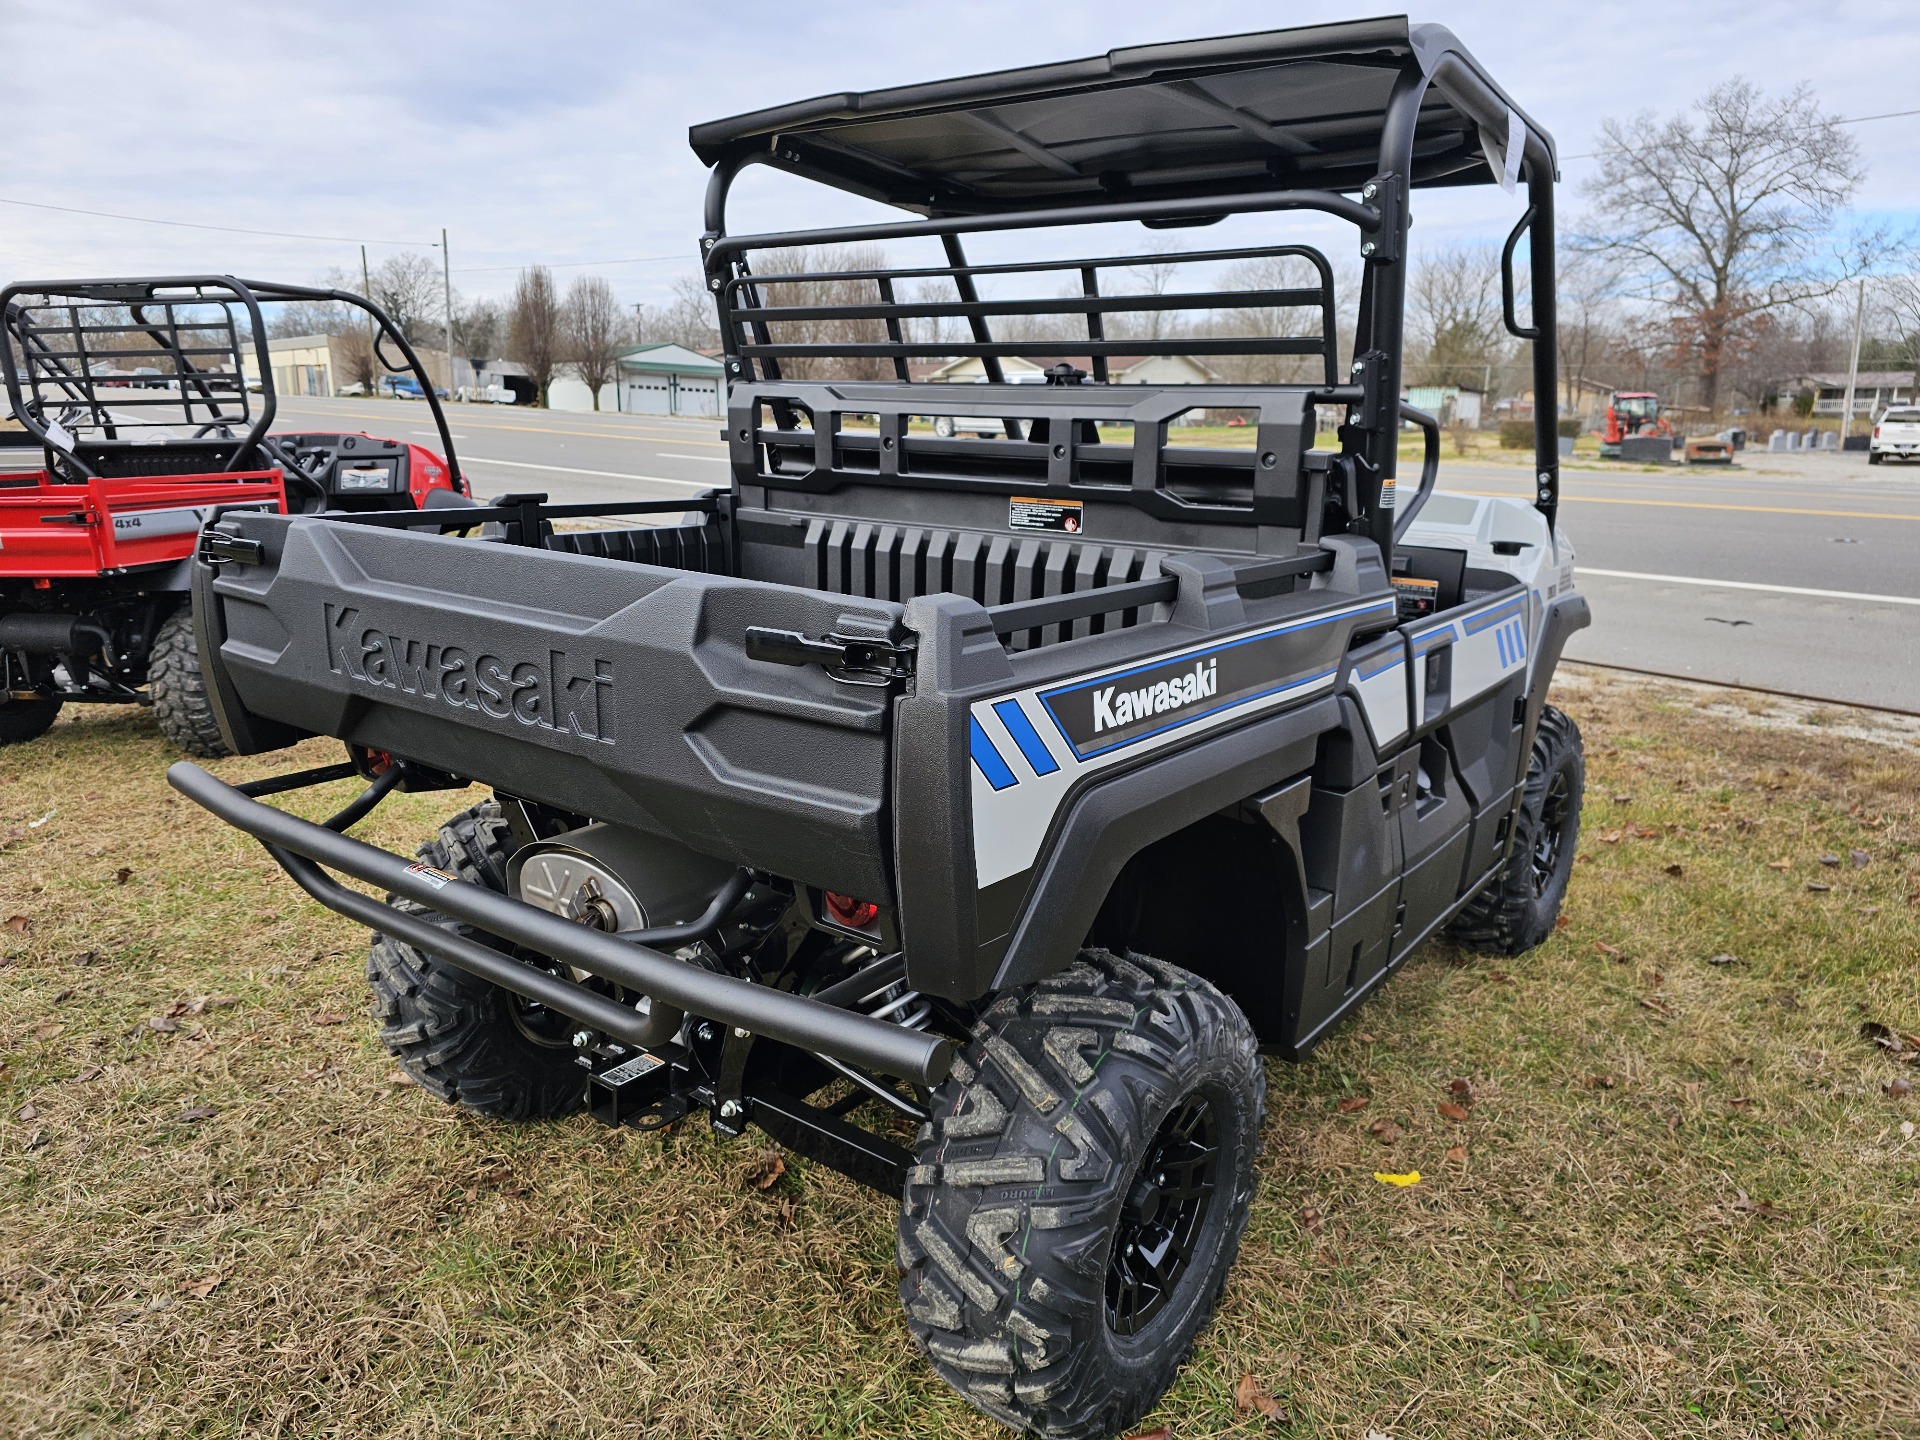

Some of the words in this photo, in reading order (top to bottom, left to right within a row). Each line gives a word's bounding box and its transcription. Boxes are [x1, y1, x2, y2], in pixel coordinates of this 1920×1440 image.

[115, 517, 142, 529] 4x4
[323, 602, 616, 745] Kawasaki
[1093, 657, 1217, 733] Kawasaki
